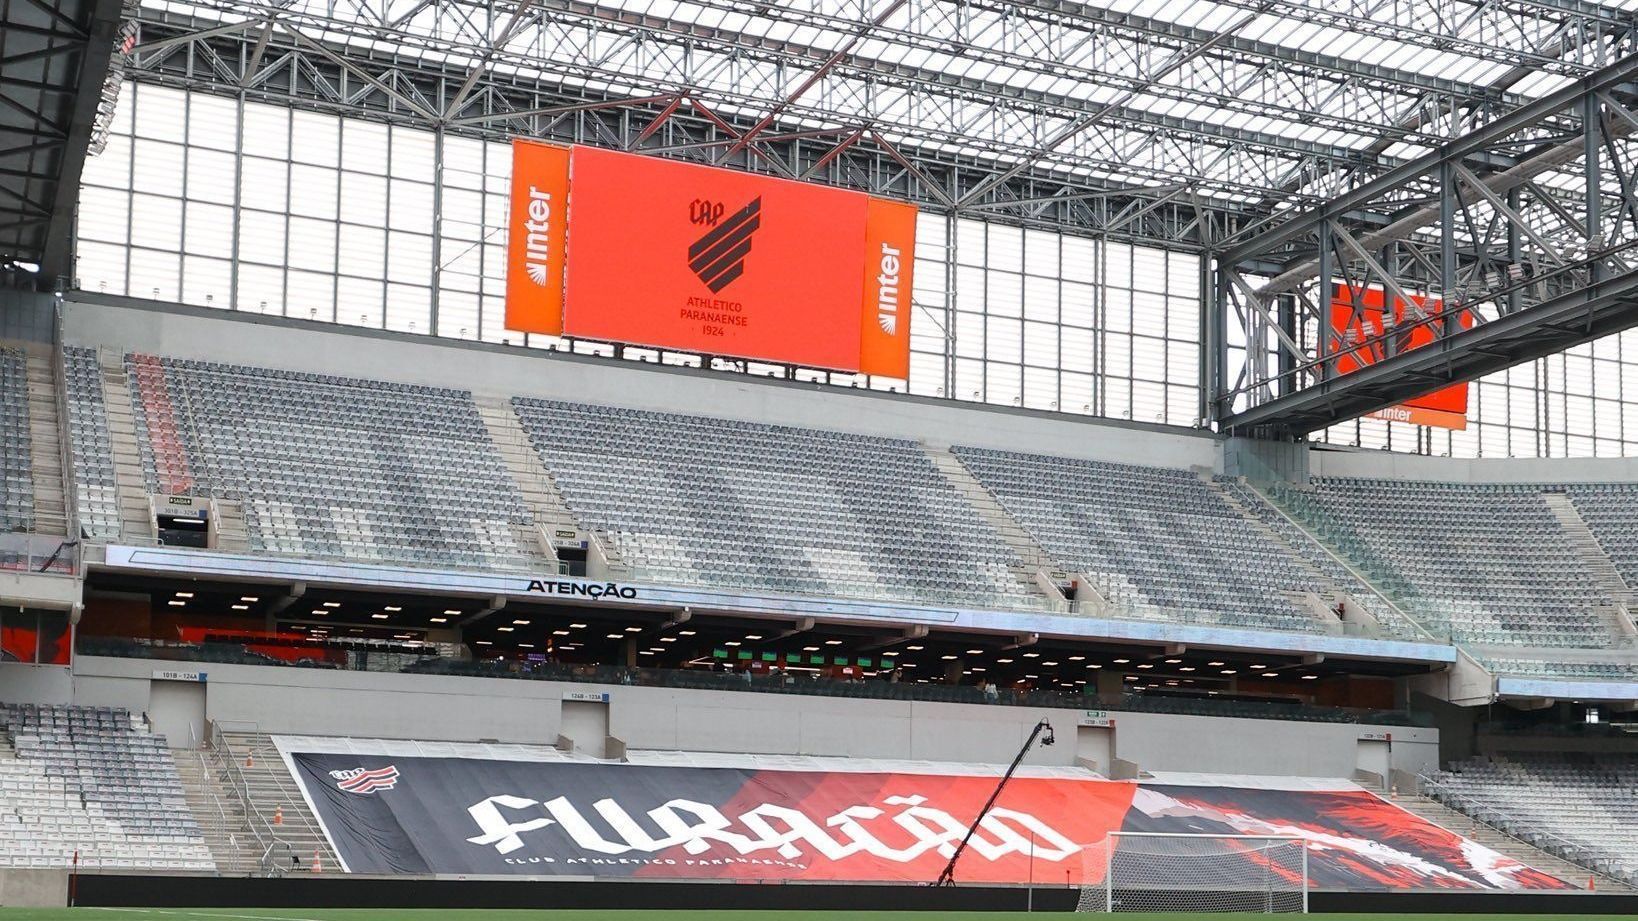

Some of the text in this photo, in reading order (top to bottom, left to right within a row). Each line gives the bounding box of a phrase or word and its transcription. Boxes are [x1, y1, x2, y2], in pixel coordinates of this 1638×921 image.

[689, 198, 725, 227] CAP
[523, 185, 552, 261] inter
[877, 242, 901, 312] inter
[686, 296, 743, 313] ATHLETICO
[680, 308, 748, 327] PARANAENSE
[702, 325, 724, 337] 1924
[1382, 408, 1412, 421] inter
[526, 580, 637, 601] ATENÇÃO
[163, 671, 178, 679] 101B
[504, 856, 808, 870] CLUB ATHLETICO PARANAENSE
